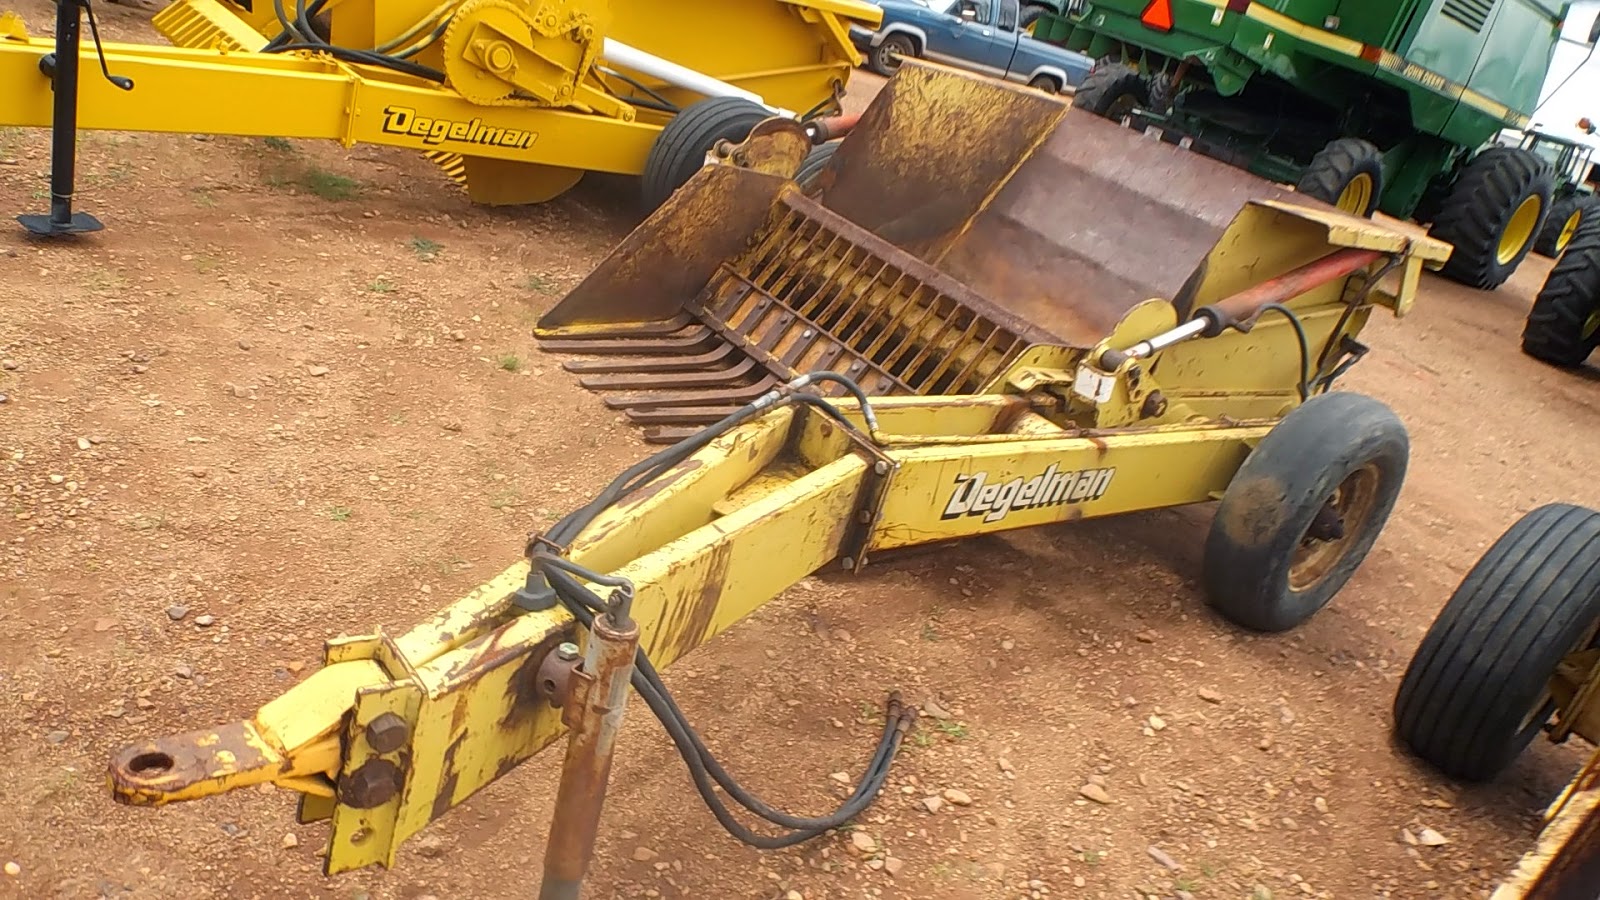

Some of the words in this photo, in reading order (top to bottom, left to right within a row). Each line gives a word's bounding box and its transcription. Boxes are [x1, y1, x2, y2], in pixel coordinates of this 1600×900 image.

[1403, 63, 1425, 81] JOHN
[1421, 71, 1446, 90] DEERE
[382, 105, 539, 149] Degelman
[940, 461, 1116, 523] Degelman
